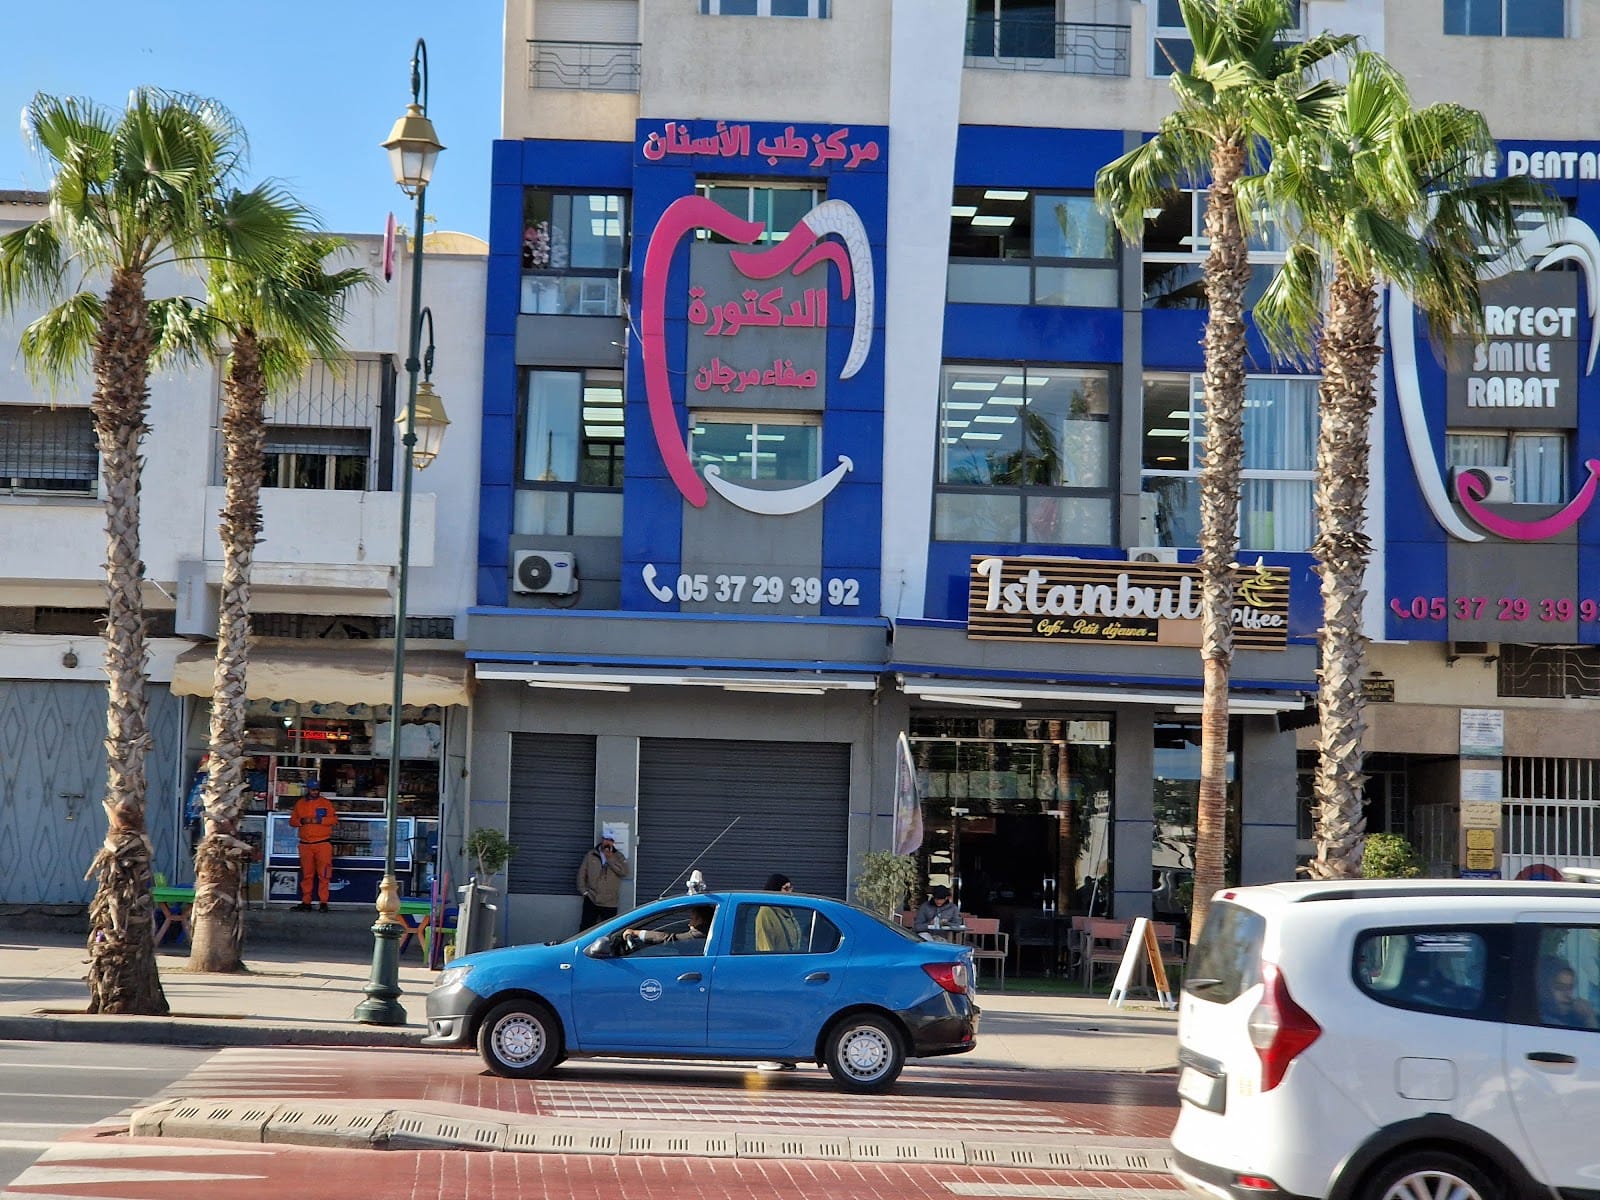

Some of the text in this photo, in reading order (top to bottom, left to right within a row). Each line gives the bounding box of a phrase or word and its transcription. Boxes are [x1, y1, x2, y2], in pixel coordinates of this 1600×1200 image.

[643, 120, 879, 168] مركز طب الأسنان
[1507, 150, 1600, 179] DENTA
[688, 287, 827, 336] الدكتورة
[1473, 342, 1551, 372] SMILE
[694, 357, 817, 392] صفاء مرجان
[1467, 377, 1560, 408] RABAT
[676, 574, 860, 606] 05 37 29 39 92
[976, 558, 1201, 619] Istanbul
[1230, 605, 1284, 630] offee
[1411, 596, 1600, 623] 05 37 29 39 9
[1071, 619, 1099, 634] Petit
